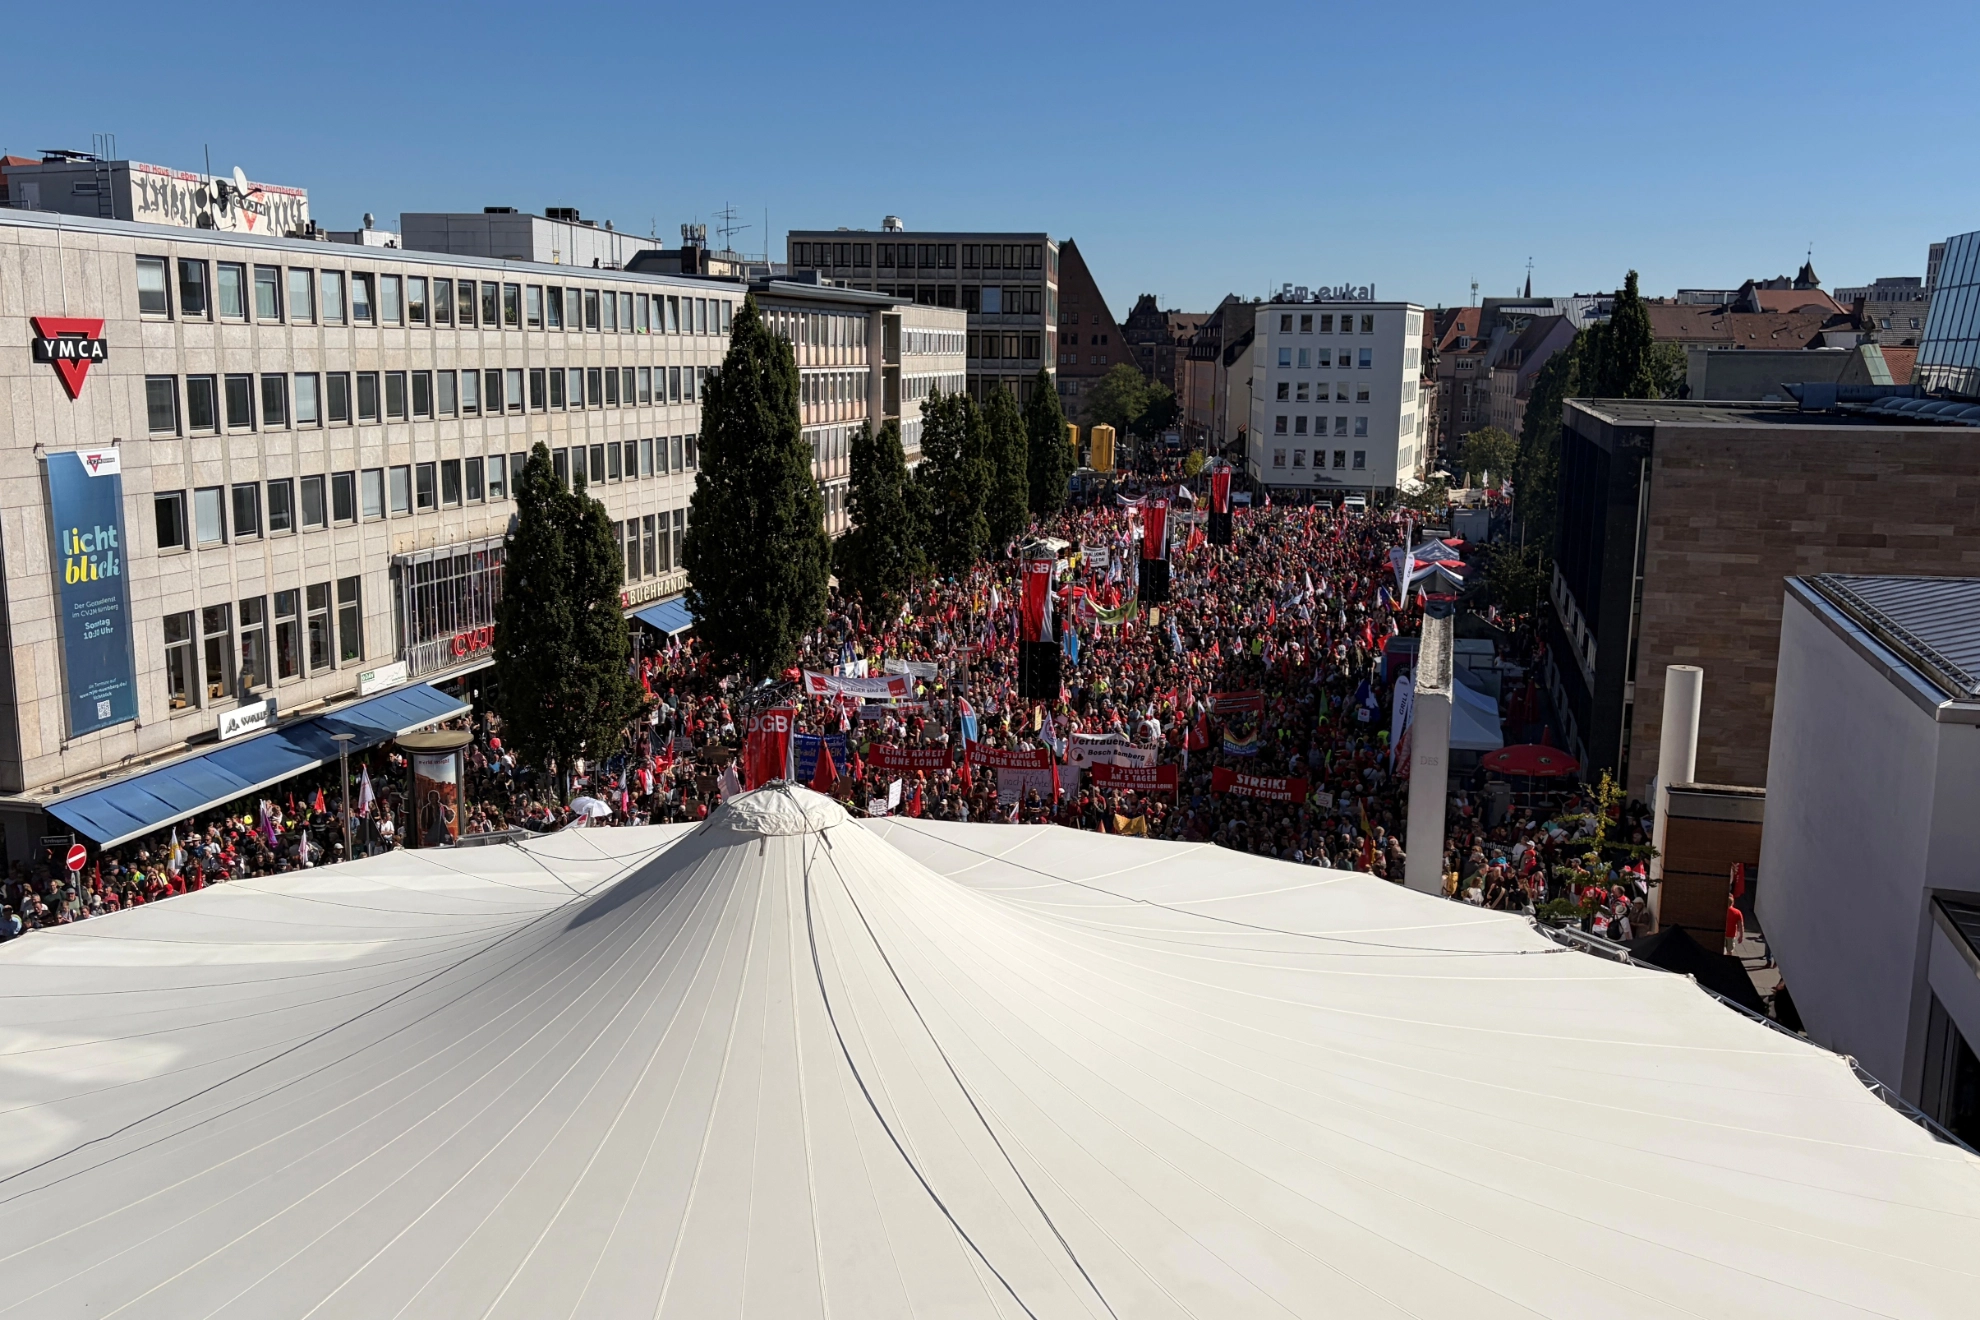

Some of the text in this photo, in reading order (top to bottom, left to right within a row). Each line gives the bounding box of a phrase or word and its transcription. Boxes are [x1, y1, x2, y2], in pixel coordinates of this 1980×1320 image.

[139, 163, 198, 181] ein Haus Leben
[234, 196, 265, 214] CVJM
[1282, 282, 1375, 301] Em-eukal
[44, 340, 103, 358] YMCA
[1146, 500, 1166, 508] DGB
[62, 525, 118, 556] licht
[64, 551, 120, 584] blick
[1023, 562, 1049, 574] DGB
[80, 608, 98, 617] CVJM
[100, 626, 114, 634] Uhr
[1398, 692, 1409, 716] GRILL
[748, 714, 788, 732] DGB
[879, 747, 908, 756] KEINE
[975, 744, 999, 756] KEINE
[1114, 750, 1145, 761] Bamberg
[884, 756, 943, 766] OHNE LOHN!
[970, 752, 1041, 768] FÜR DEN KRIEG!
[1420, 756, 1438, 766] DES
[1107, 780, 1125, 788] GESETZ
[1132, 774, 1157, 782] TAGEN
[1236, 774, 1286, 790] STREIK!
[1229, 784, 1292, 800] JETZT SOFORT!
